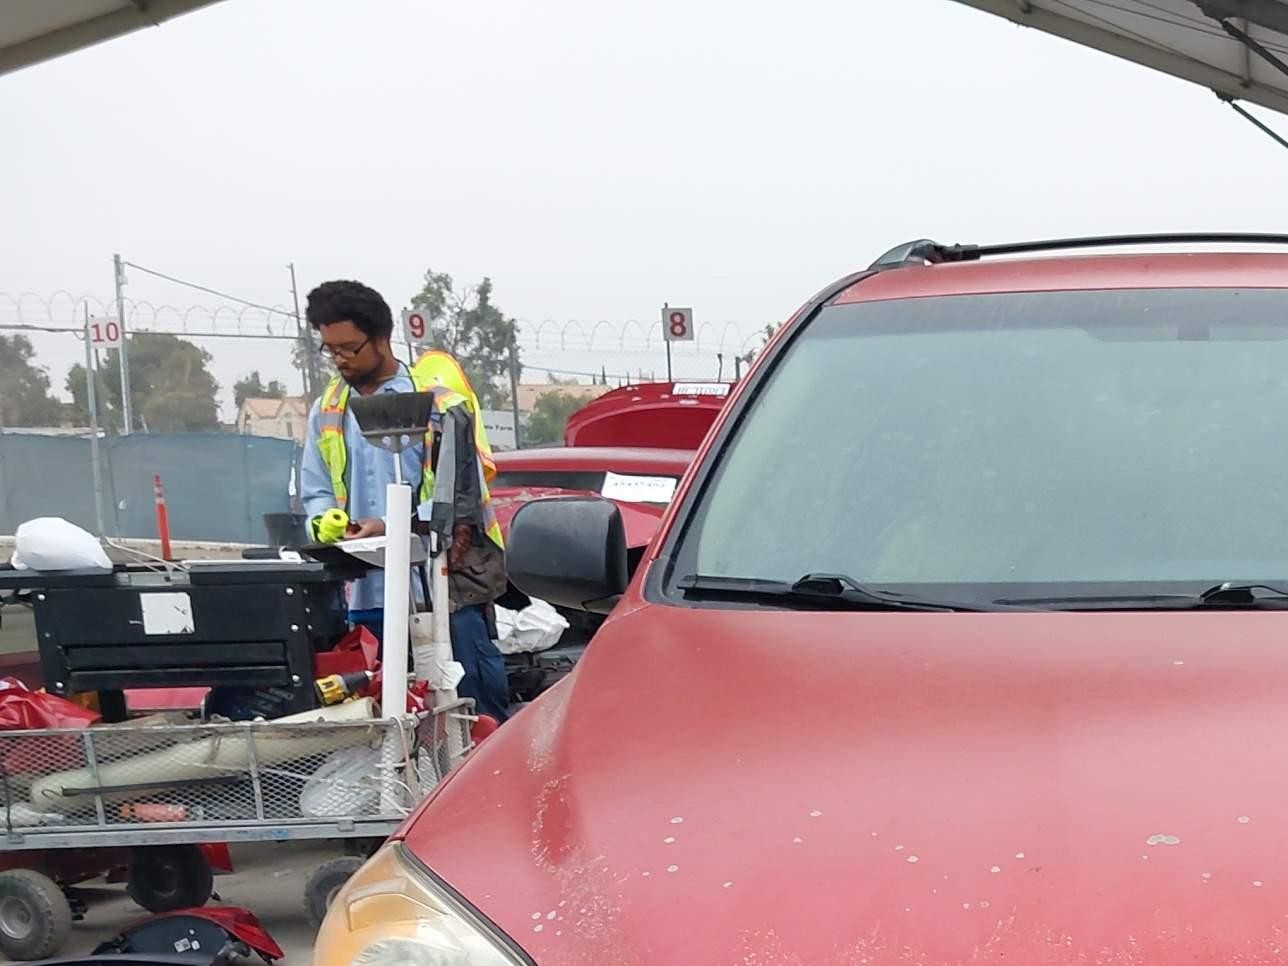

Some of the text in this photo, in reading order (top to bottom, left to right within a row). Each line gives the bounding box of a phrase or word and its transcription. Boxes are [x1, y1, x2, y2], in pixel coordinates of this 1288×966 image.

[91, 322, 119, 342] 10
[409, 314, 425, 339] 9
[670, 312, 687, 337] 8
